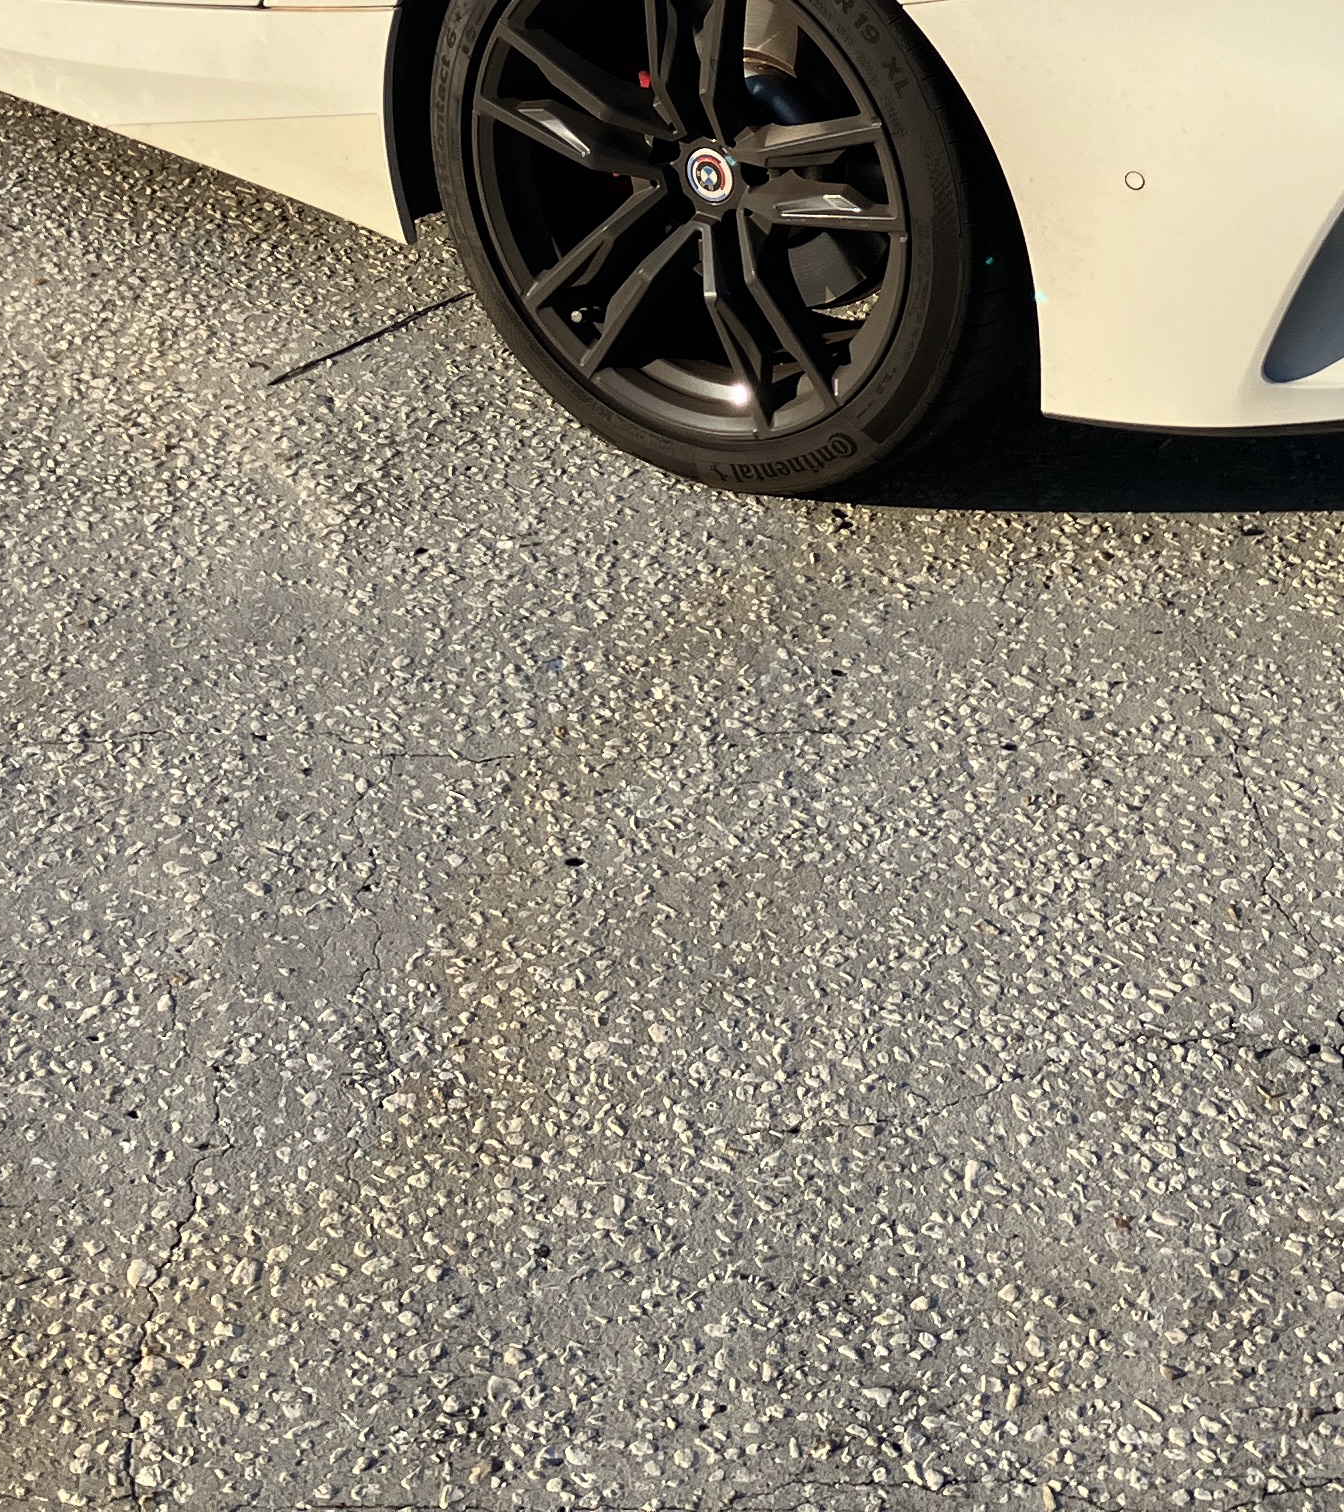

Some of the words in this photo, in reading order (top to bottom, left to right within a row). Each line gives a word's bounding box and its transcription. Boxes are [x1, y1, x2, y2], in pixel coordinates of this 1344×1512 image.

[854, 12, 881, 45] 19
[882, 56, 911, 99] XL
[730, 432, 858, 483] Continental
